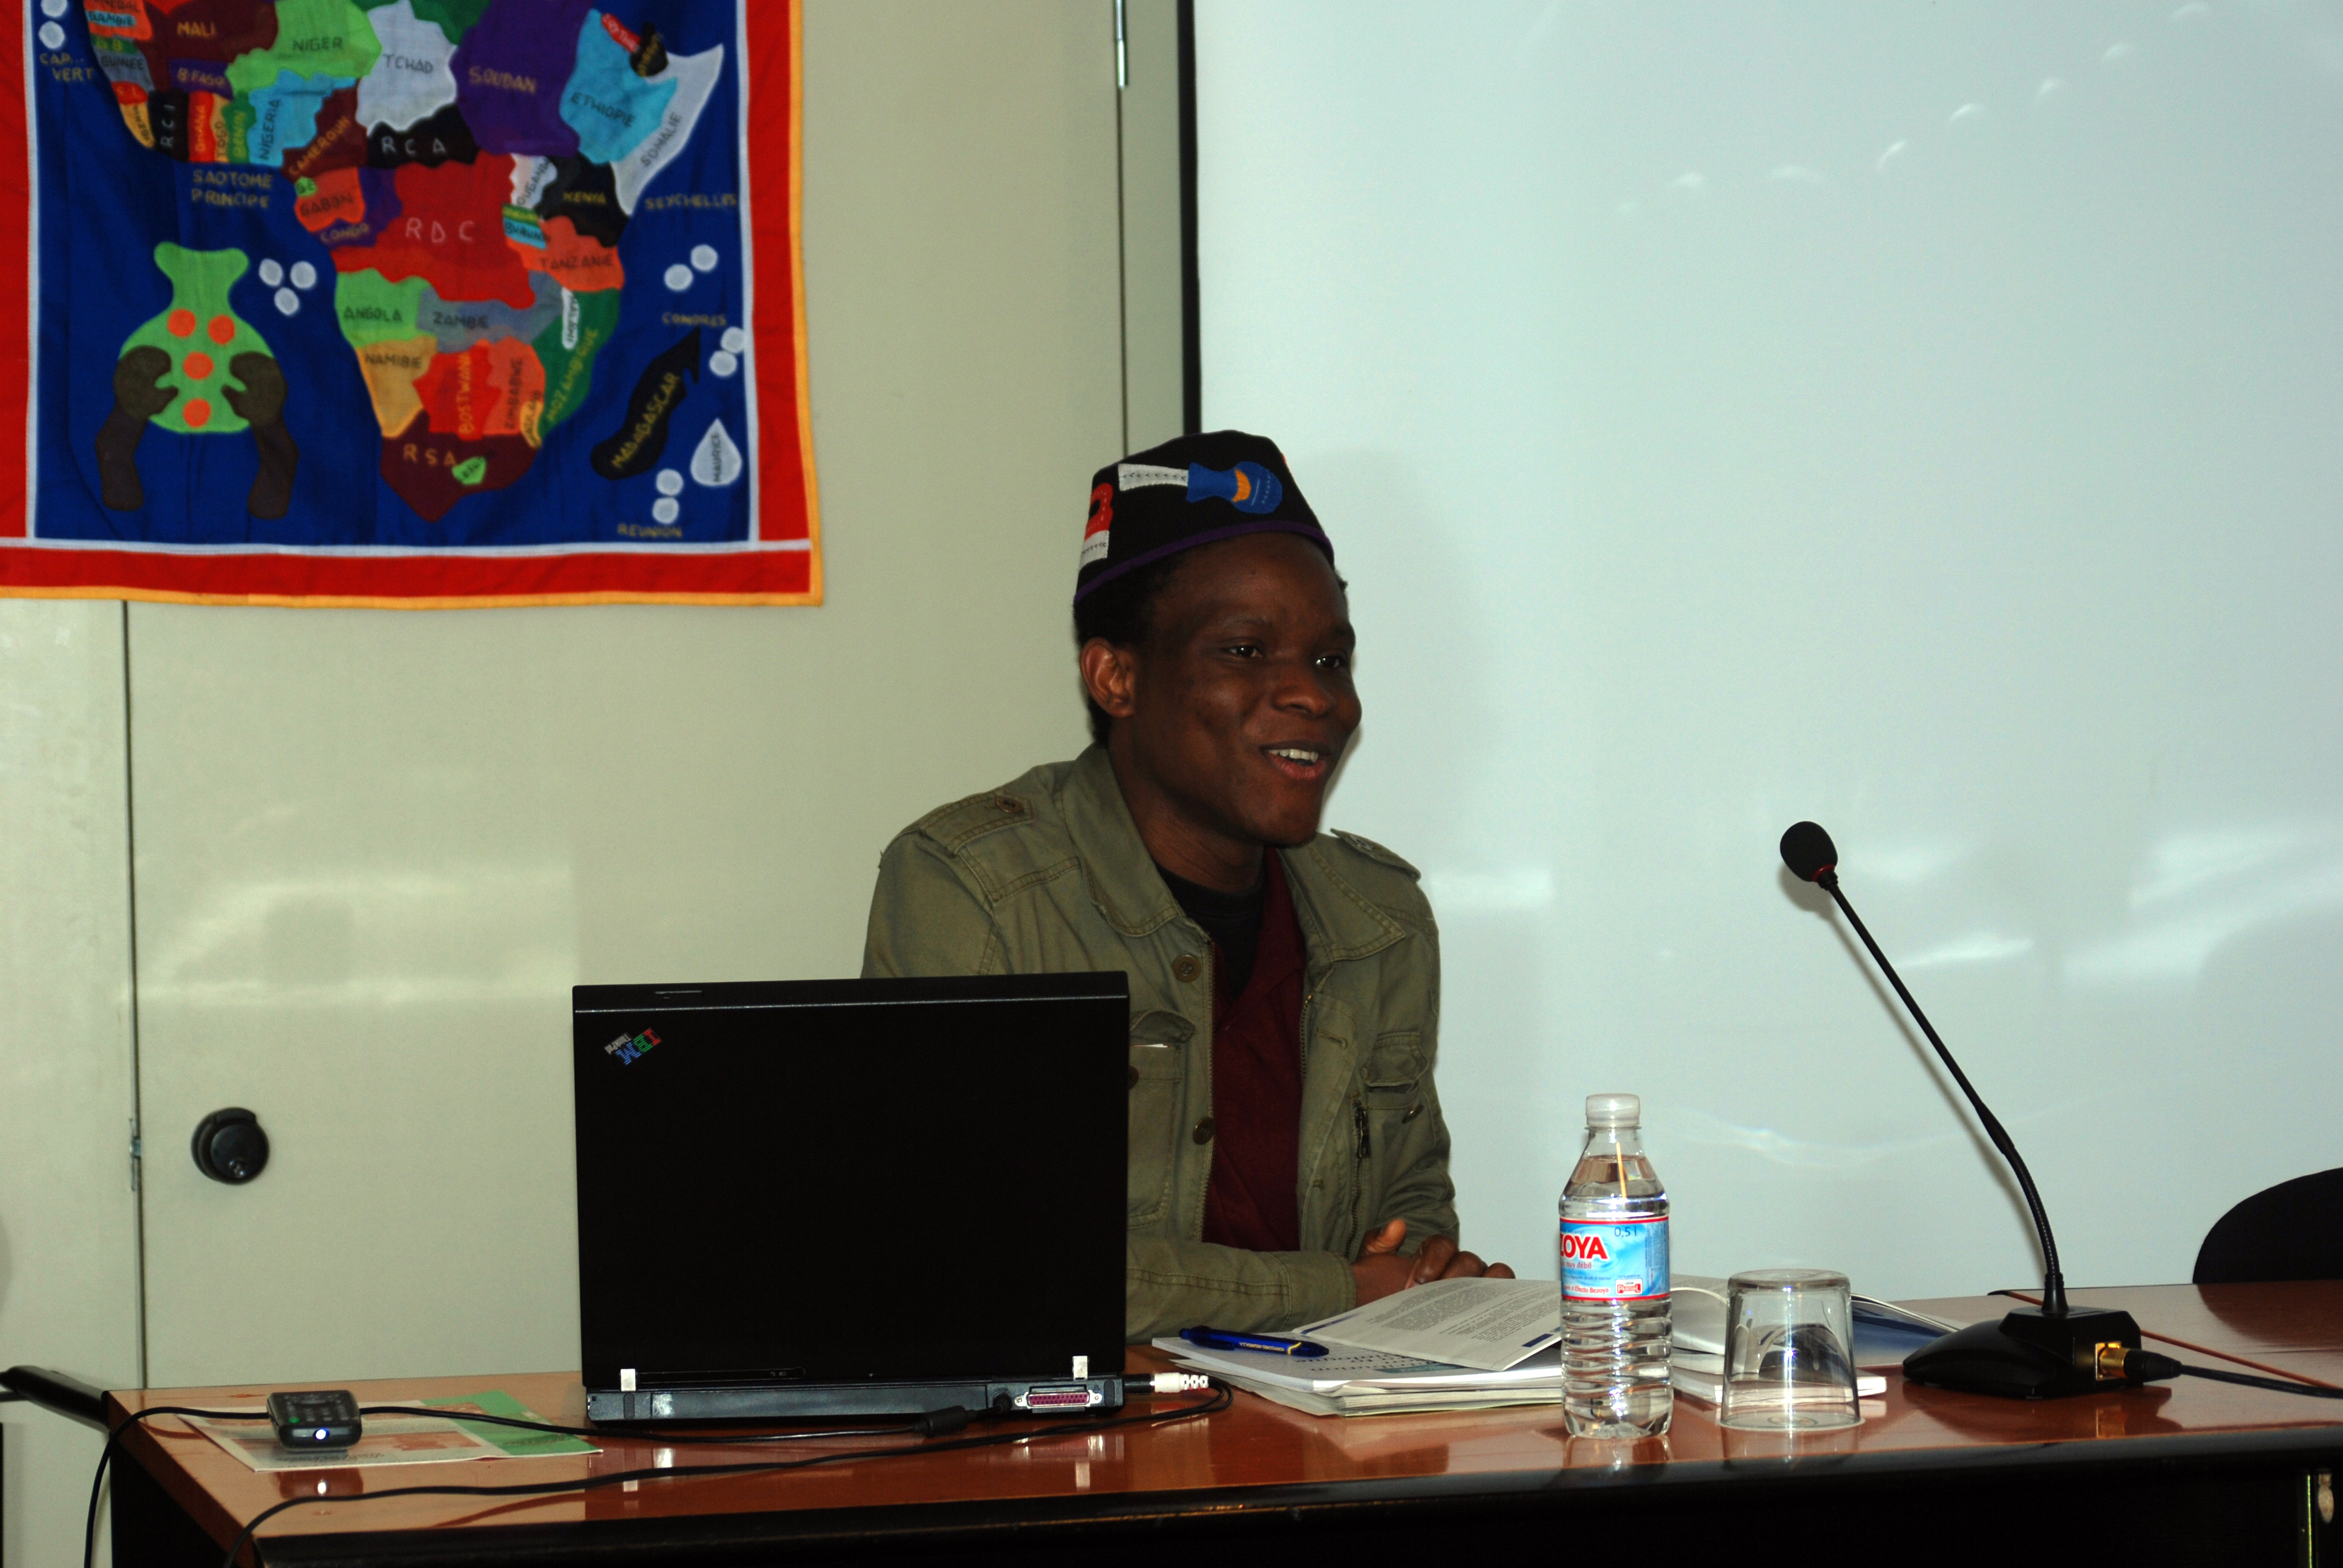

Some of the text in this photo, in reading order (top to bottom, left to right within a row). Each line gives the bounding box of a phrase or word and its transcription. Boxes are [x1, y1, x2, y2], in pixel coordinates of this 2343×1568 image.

[177, 22, 215, 38] MALI
[293, 36, 343, 51] NIGER
[52, 68, 93, 82] VERT
[384, 54, 434, 74] TCHAD
[468, 66, 537, 94] SOUDAN
[570, 91, 637, 128] ETHIOPIE
[214, 121, 228, 158] TOGO
[260, 99, 282, 161] NIGERIA
[641, 112, 682, 167] SOMALIE
[289, 117, 349, 177] CAMEROUN
[191, 188, 269, 208] PRINCIPE
[300, 192, 353, 215] GABON
[563, 191, 606, 204] KENYA
[645, 194, 738, 209] SEYCHELLES
[343, 304, 402, 322] ANGOLA
[611, 371, 680, 469] MADAGASCAR
[710, 432, 723, 483] MAURICE
[617, 523, 683, 538] REUNION
[605, 1033, 631, 1054] ThinkPad
[615, 1028, 662, 1065] IBM
